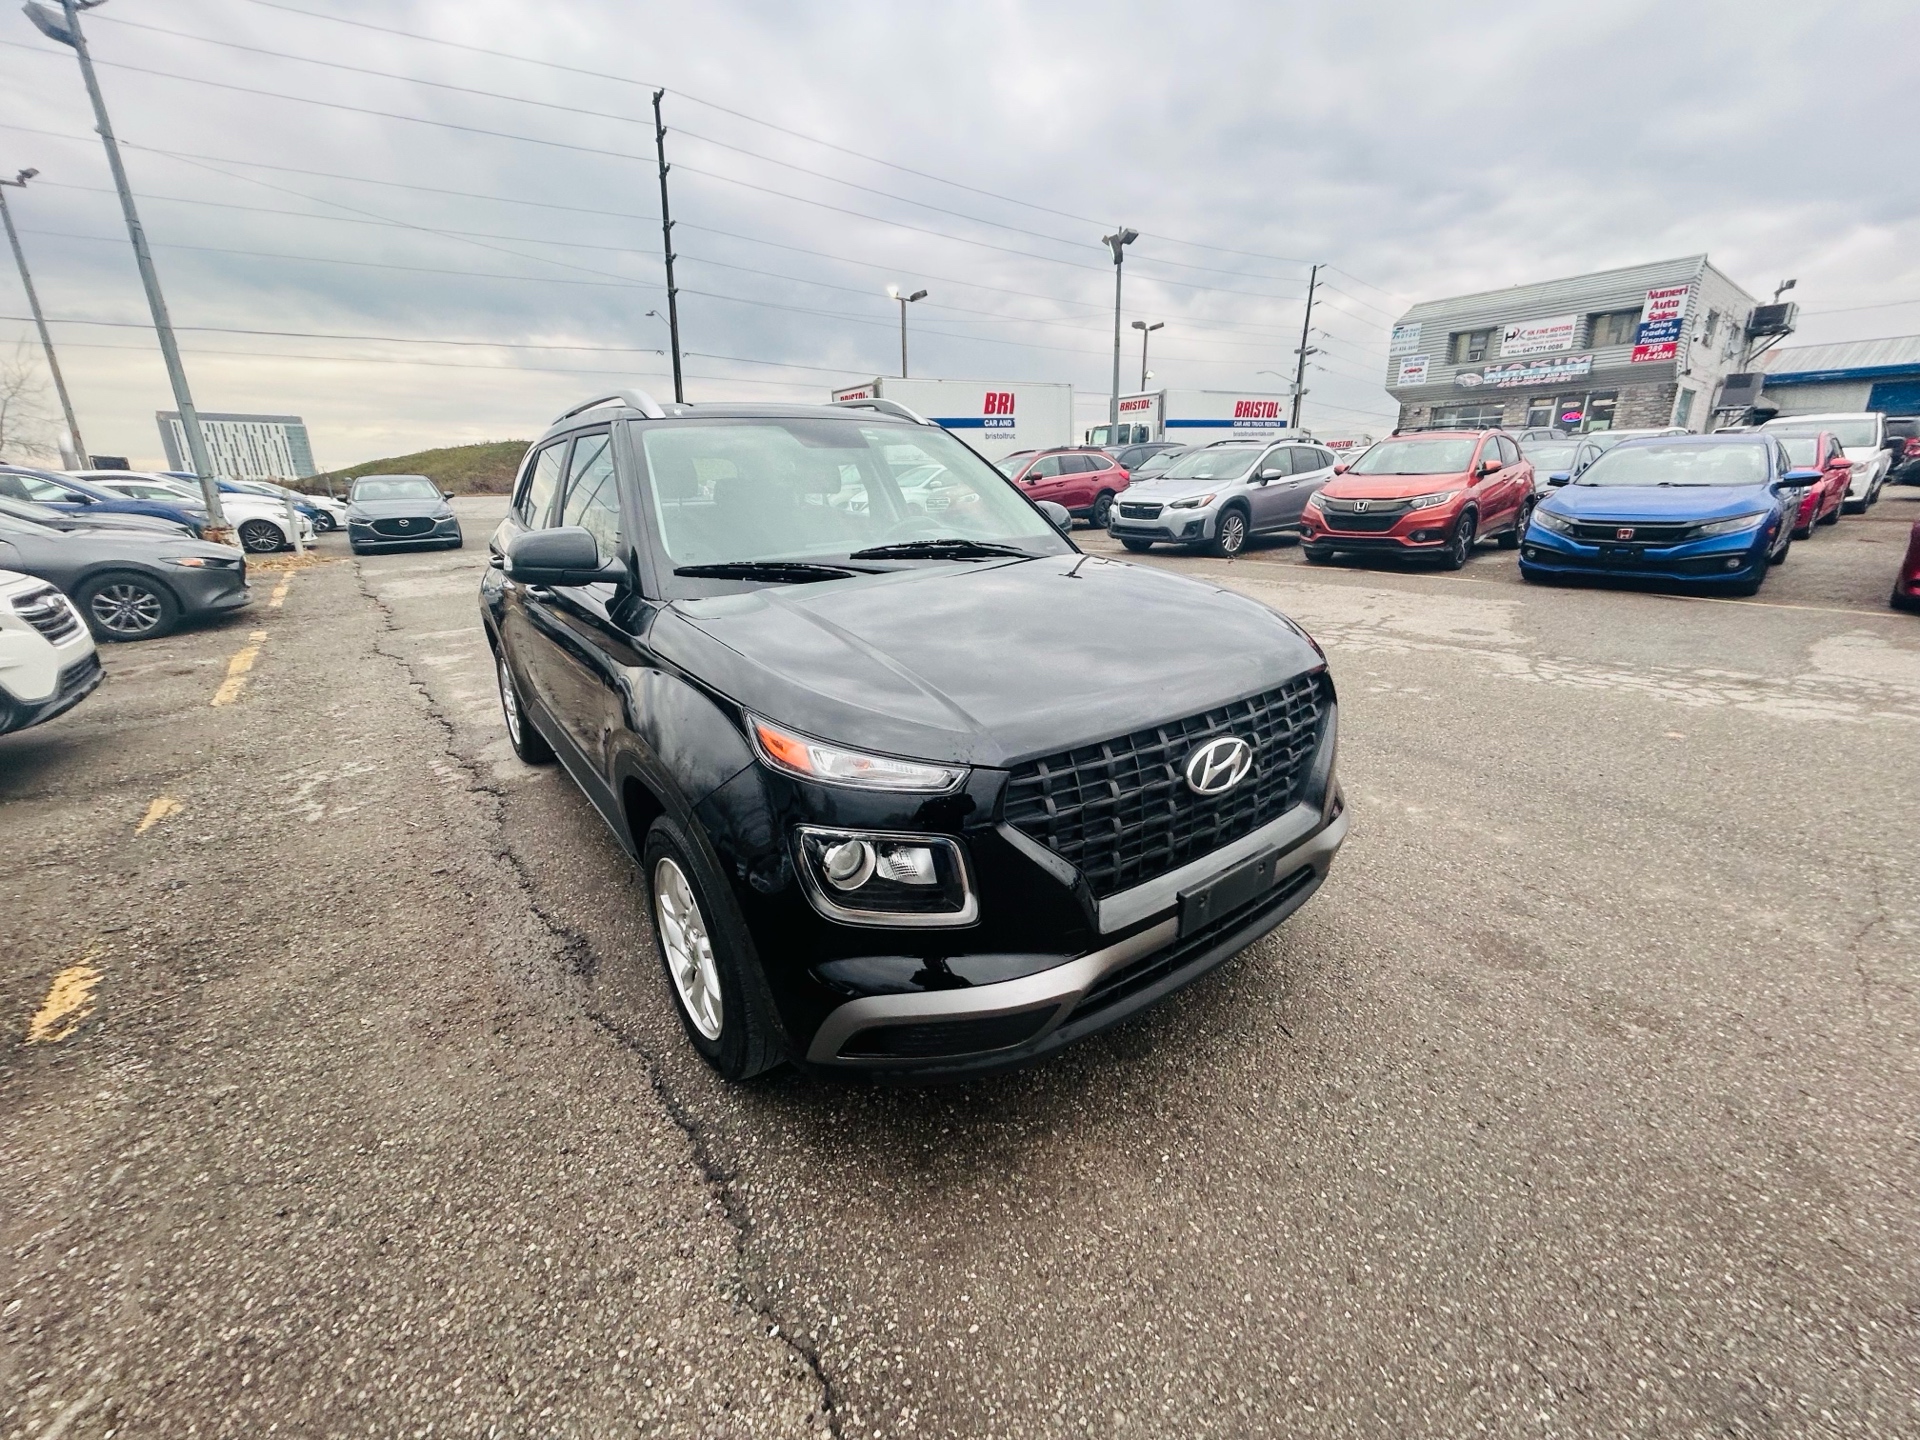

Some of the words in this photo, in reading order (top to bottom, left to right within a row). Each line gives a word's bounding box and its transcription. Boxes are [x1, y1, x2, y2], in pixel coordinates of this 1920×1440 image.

[1648, 285, 1689, 300] Numeri
[1650, 300, 1680, 310] Auto
[1648, 311, 1678, 321] Sales
[1550, 325, 1573, 333] MOTORS
[1648, 321, 1673, 329] Sales
[1640, 329, 1666, 338] Trade
[1640, 336, 1675, 344] Finance
[1647, 345, 1664, 353] 289
[1634, 351, 1673, 362] 314-4204
[1484, 355, 1593, 373] HAKIM
[1485, 369, 1533, 379] AUTO
[984, 392, 1015, 414] BRI
[1120, 399, 1150, 411] BRISTOL
[1234, 400, 1279, 418] BRISTOL
[984, 419, 998, 427] CAR
[999, 419, 1012, 427] AND
